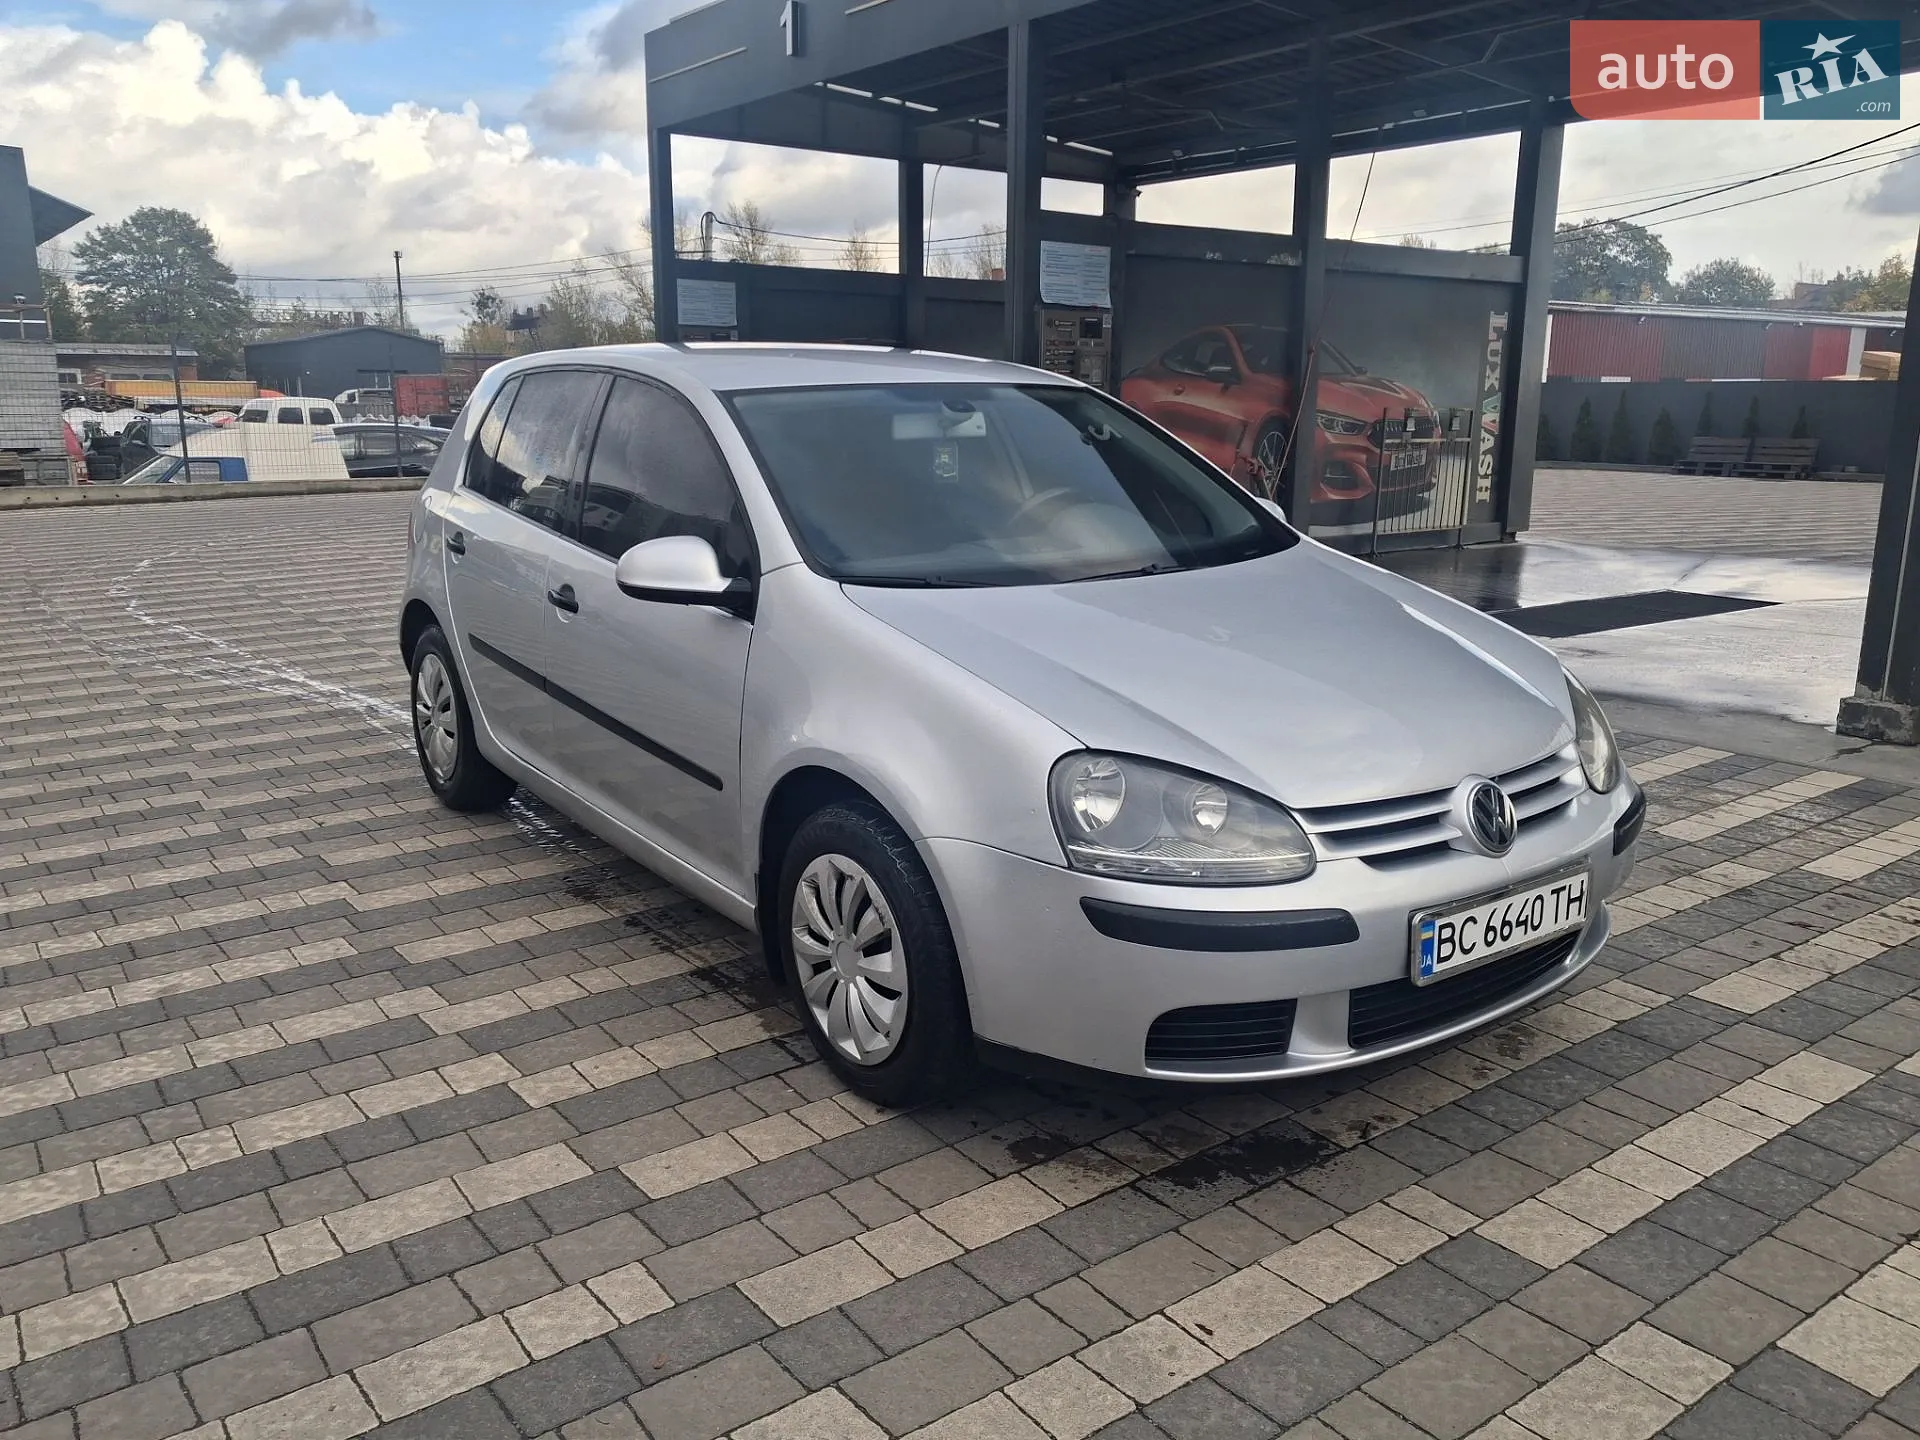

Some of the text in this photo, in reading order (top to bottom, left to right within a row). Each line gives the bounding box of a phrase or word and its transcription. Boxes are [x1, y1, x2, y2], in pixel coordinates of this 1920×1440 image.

[779, 0, 797, 56] 1
[1437, 879, 1585, 965] BC 6640 TH
